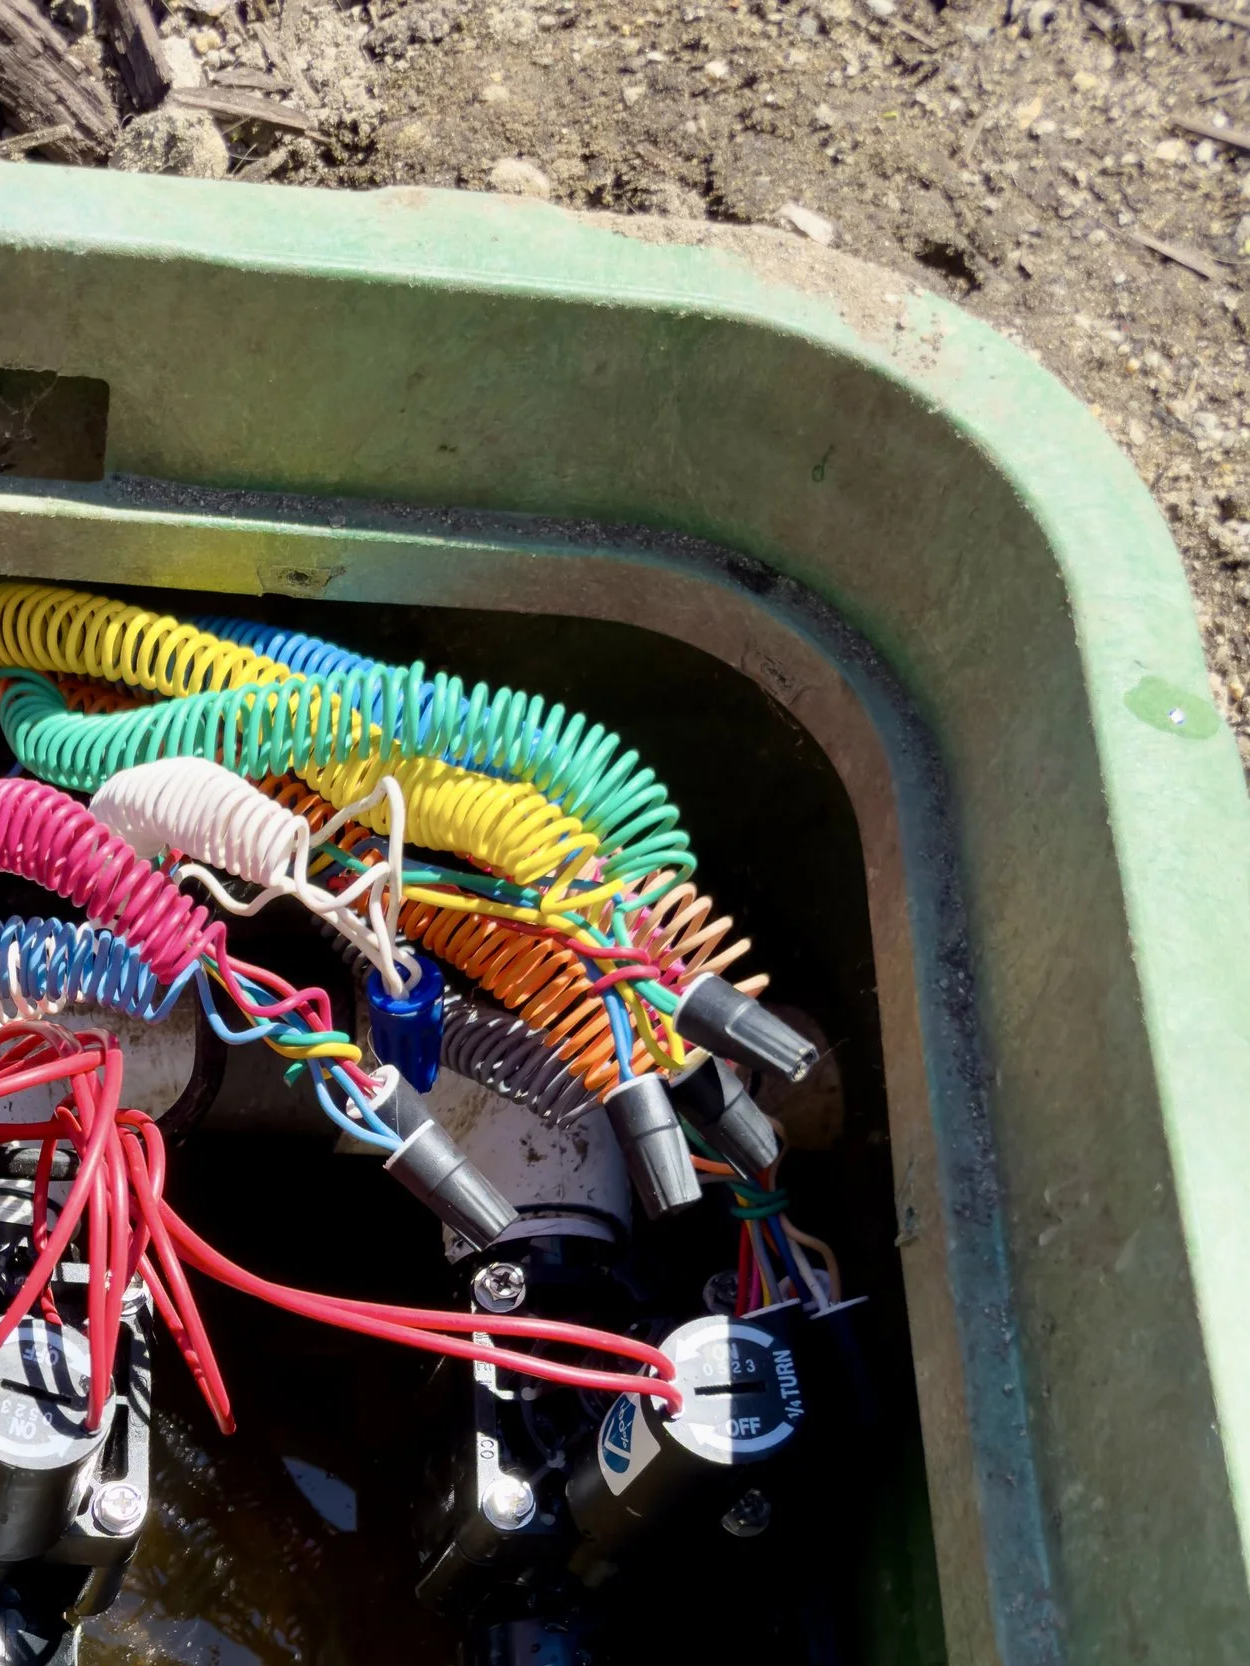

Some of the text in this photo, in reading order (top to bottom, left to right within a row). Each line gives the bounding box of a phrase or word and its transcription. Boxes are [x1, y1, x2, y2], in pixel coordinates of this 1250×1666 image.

[21, 1345, 61, 1366] OFF
[712, 1342, 740, 1362] ON
[772, 1349, 800, 1398] TURN
[8, 1417, 38, 1441] ON
[725, 1417, 761, 1437] OFF
